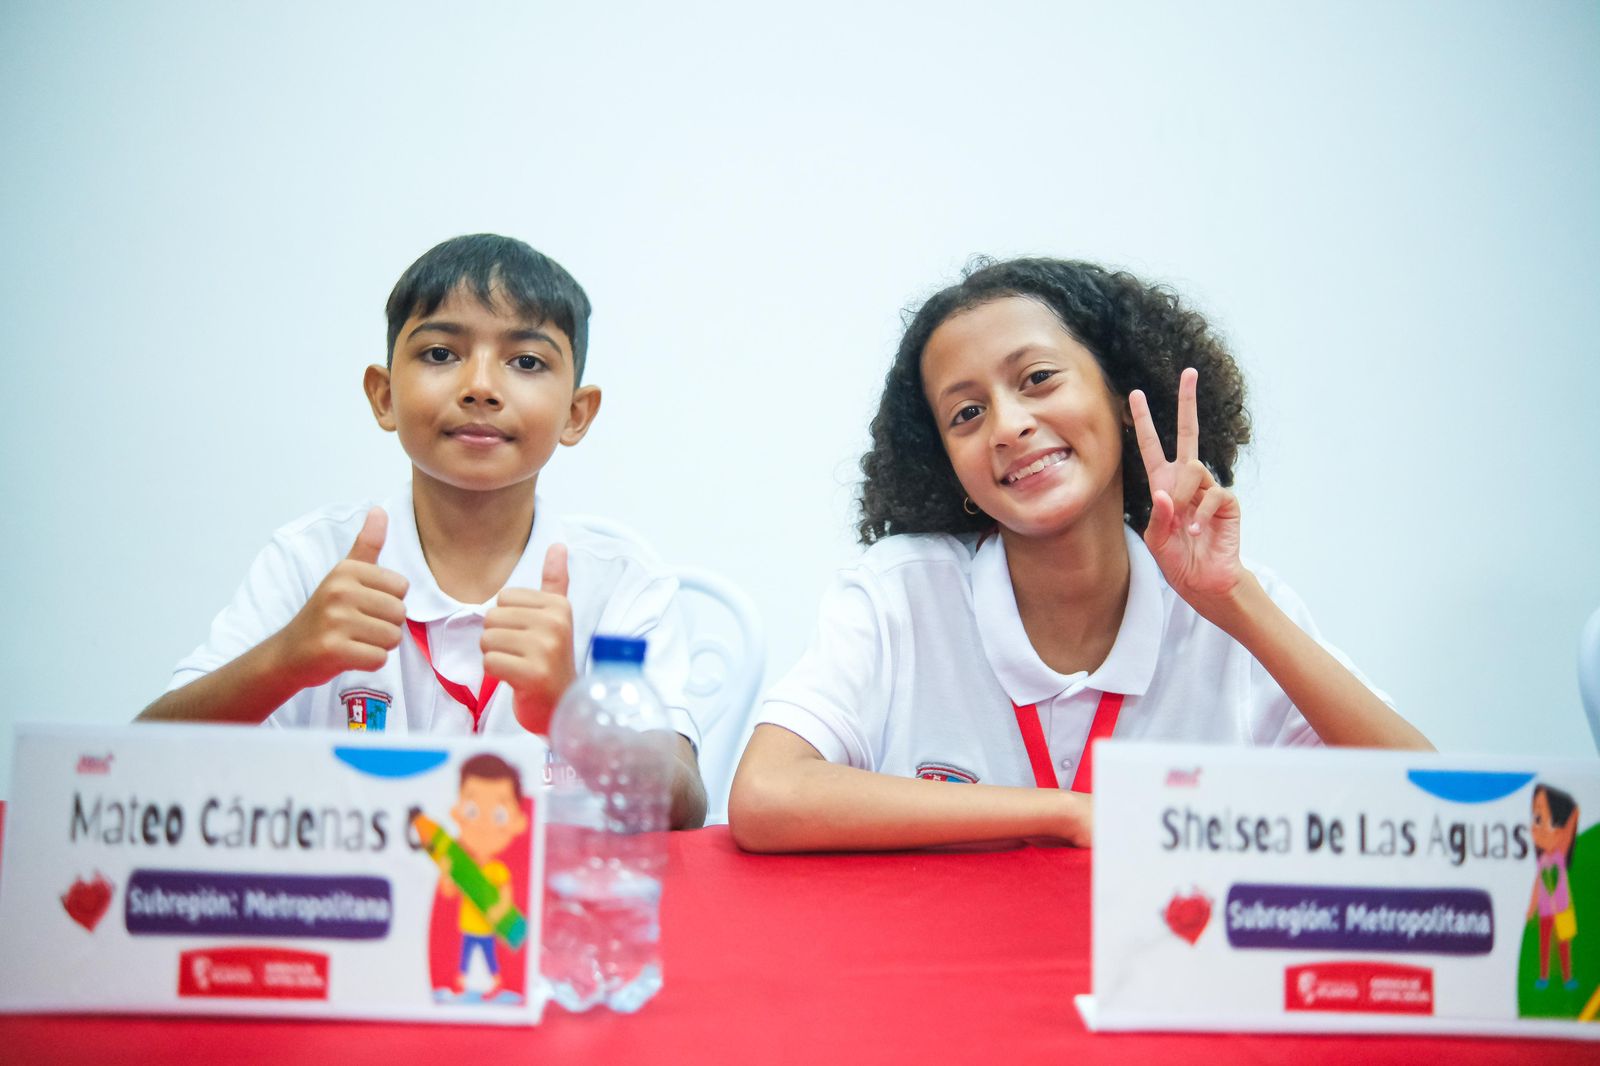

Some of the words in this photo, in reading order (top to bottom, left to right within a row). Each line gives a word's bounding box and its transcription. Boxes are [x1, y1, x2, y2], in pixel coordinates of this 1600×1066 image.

[71, 792, 183, 845] Mateo
[200, 797, 388, 852] Cárdenas
[1162, 806, 1292, 854] Shelsea
[1307, 811, 1345, 855] De
[1360, 812, 1416, 857] Las
[1427, 813, 1528, 867] Aguas
[130, 885, 238, 925] Subregión:
[244, 889, 389, 927] Metropolitana
[1229, 900, 1339, 939] Subregión:
[1345, 903, 1490, 942] Metropolitana
